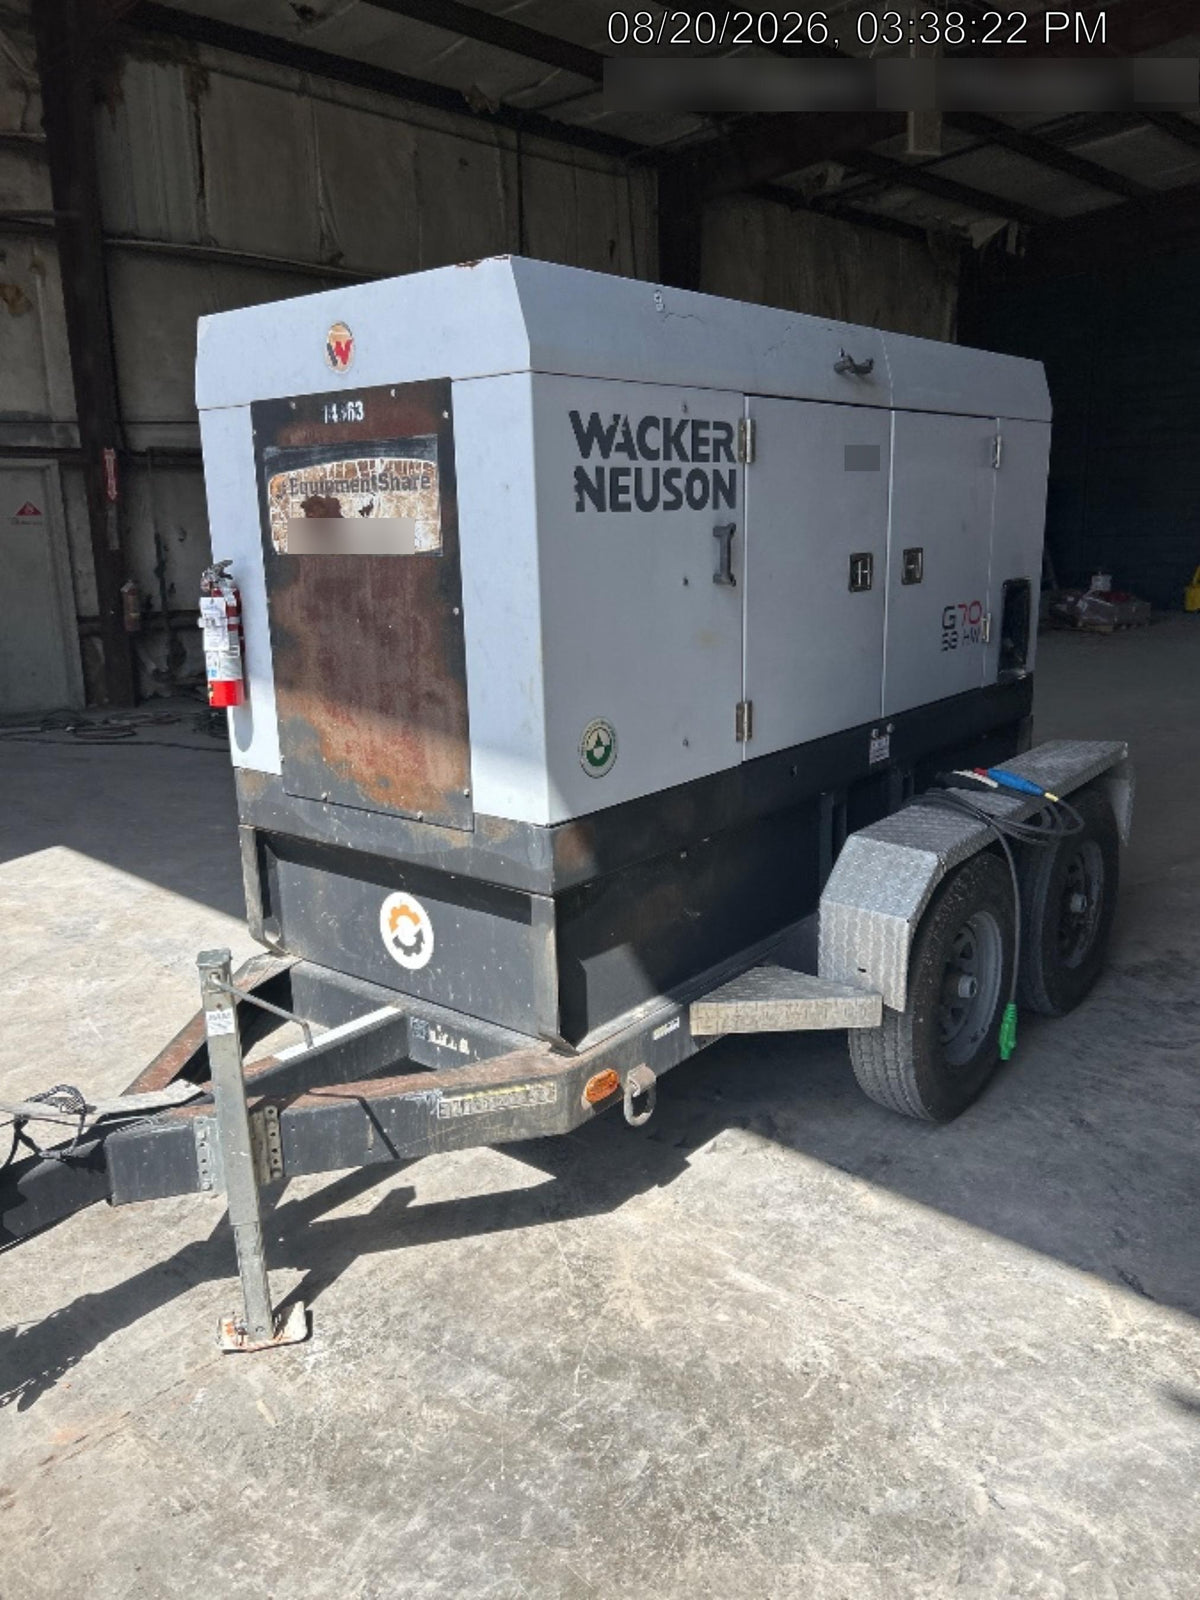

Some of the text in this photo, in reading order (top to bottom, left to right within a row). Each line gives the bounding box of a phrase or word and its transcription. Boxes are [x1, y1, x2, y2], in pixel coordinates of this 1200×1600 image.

[323, 401, 364, 424] 1463
[568, 410, 737, 464] WACKER
[289, 472, 431, 496] EquipmentShare
[574, 465, 737, 513] NEUSON
[942, 600, 982, 630] G70
